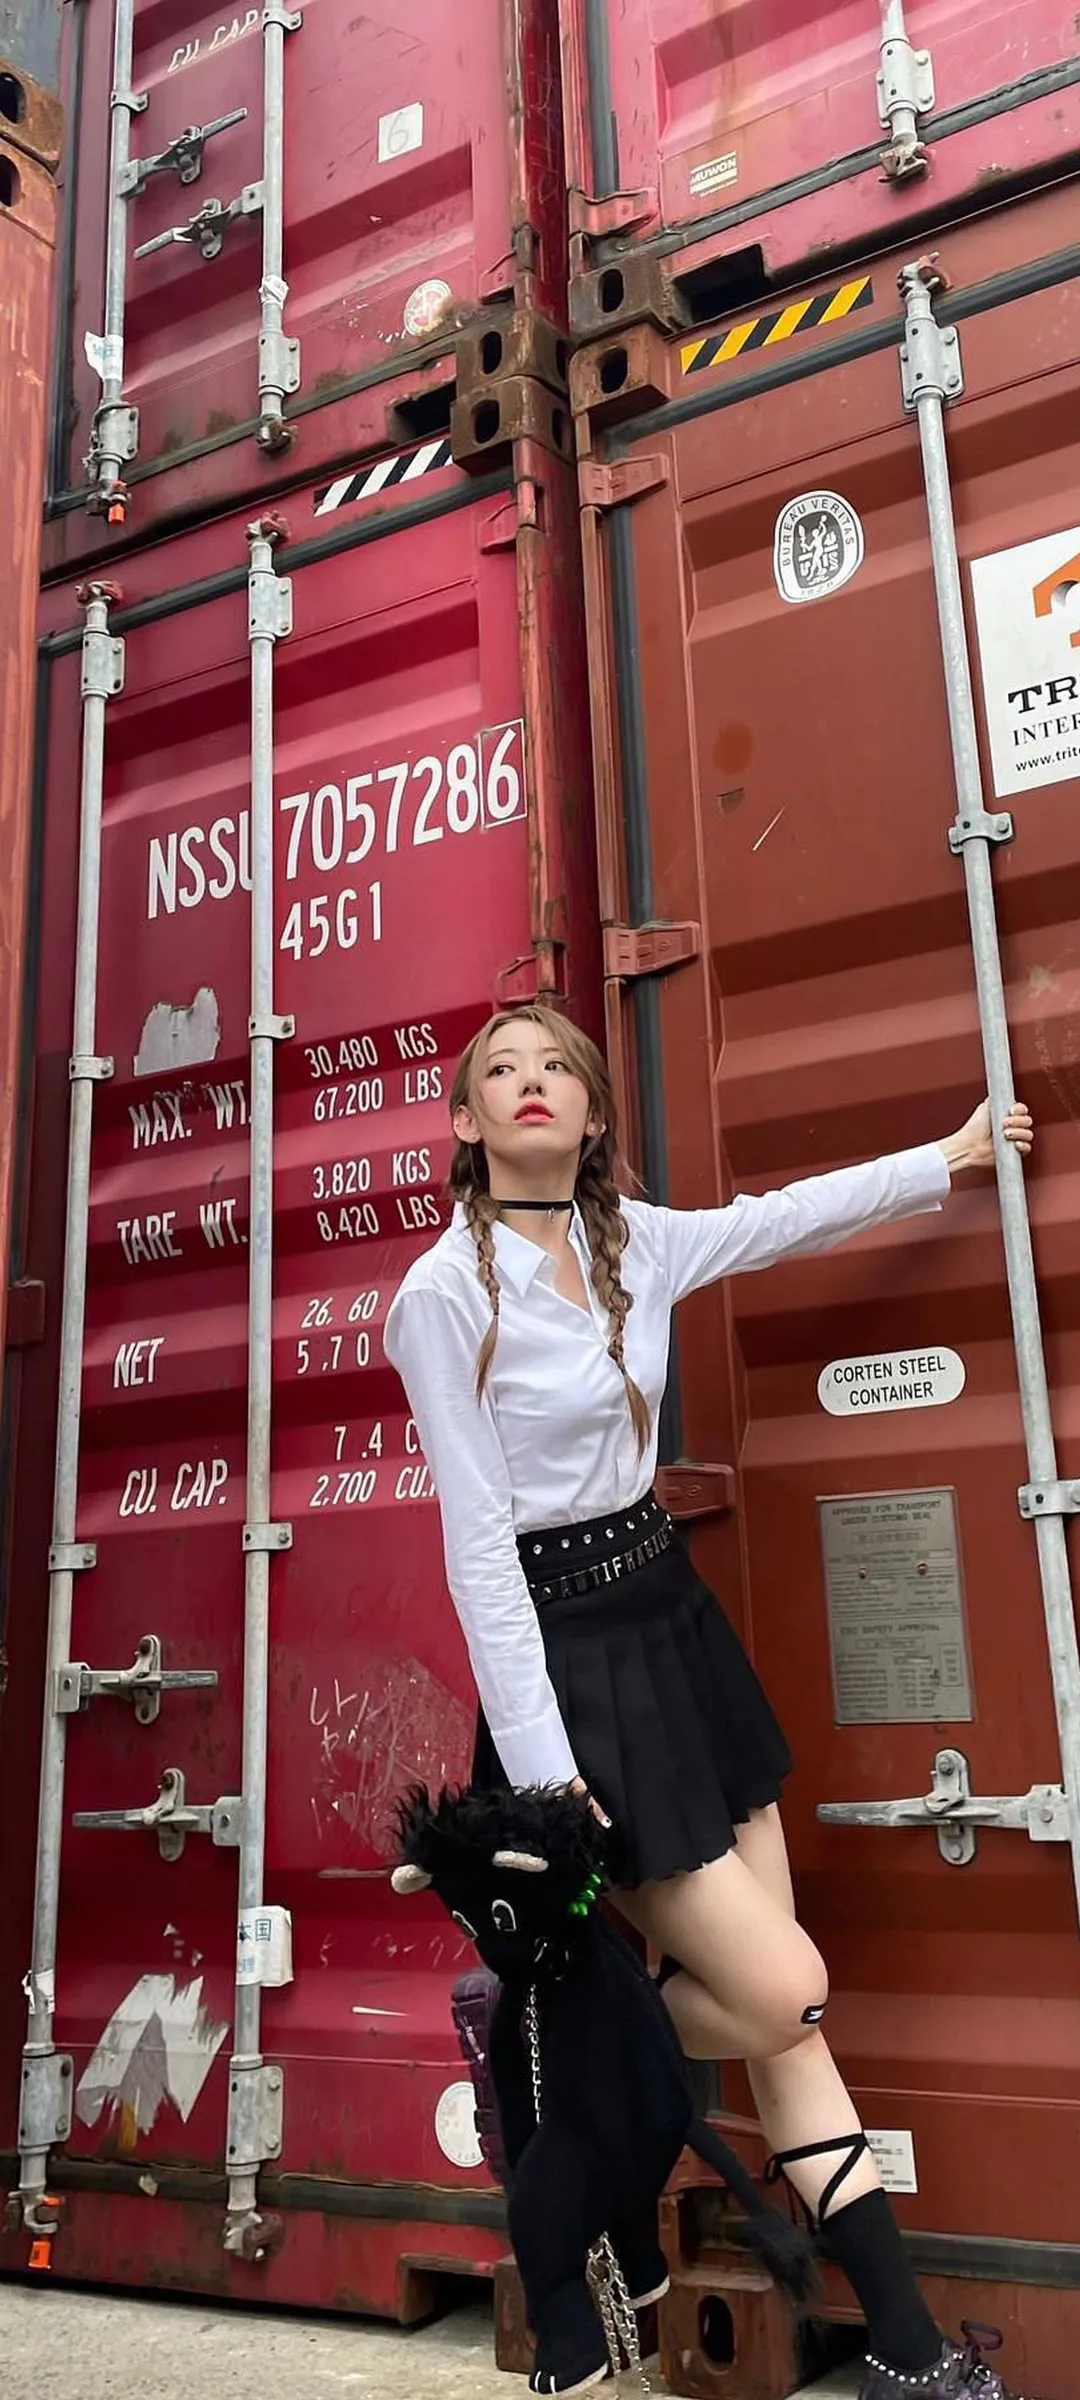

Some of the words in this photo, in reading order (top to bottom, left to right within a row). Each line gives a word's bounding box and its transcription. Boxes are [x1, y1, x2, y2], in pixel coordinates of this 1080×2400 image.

[387, 111, 409, 154] 6
[783, 504, 806, 566] BUREAU
[811, 499, 855, 544] VERITAS
[1007, 675, 1080, 714] TR
[1016, 745, 1080, 772] www.trit
[280, 881, 382, 960] 45G1
[394, 1023, 438, 1060] KGS
[128, 1094, 192, 1149] MAX.
[404, 1066, 443, 1103] LBS
[391, 1148, 431, 1186] KGS
[117, 1211, 182, 1264] TARE
[200, 1198, 248, 1248] WT.
[396, 1194, 441, 1230] LBS
[114, 1337, 164, 1388] NET
[834, 1362, 893, 1384] CORTEN
[899, 1356, 946, 1376] STEEL
[850, 1381, 934, 1406] CONTAINER
[119, 1467, 156, 1517] CU.
[171, 1459, 228, 1510] CAP.
